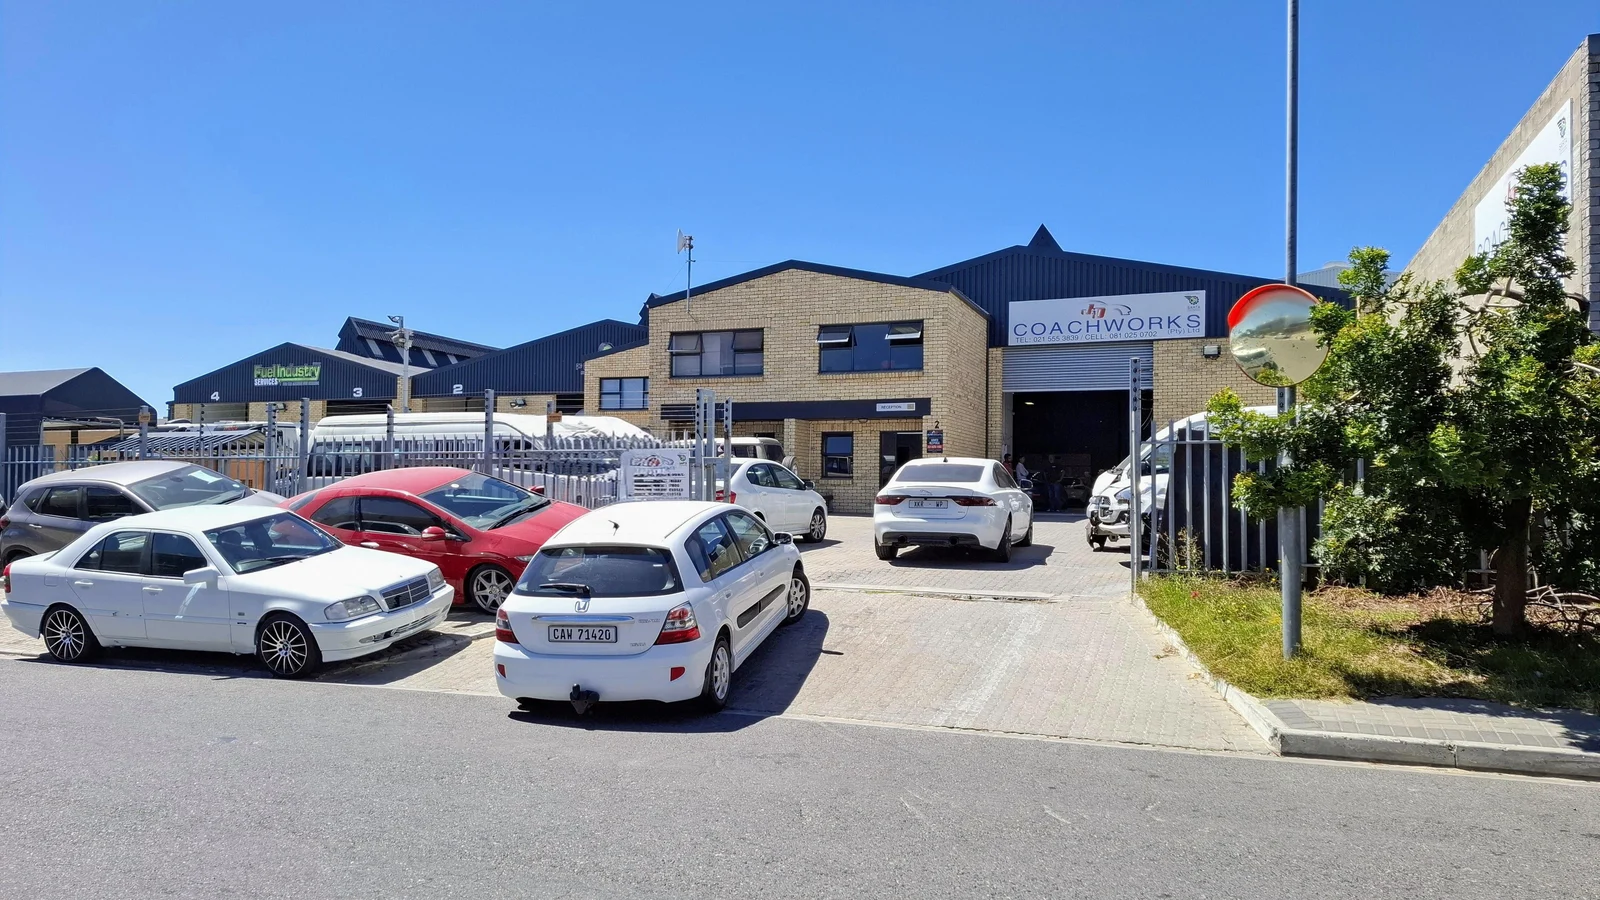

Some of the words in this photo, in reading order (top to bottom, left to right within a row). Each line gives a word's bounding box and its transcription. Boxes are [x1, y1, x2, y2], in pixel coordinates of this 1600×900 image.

[1013, 314, 1201, 337] COACHWORKS
[1015, 336, 1032, 344] TEL:
[1062, 334, 1079, 342] 3839
[1084, 333, 1107, 341] CELL:
[1124, 331, 1138, 339] 025
[1140, 330, 1158, 338] 0702
[253, 364, 276, 378] Fuel
[277, 362, 321, 380] Industry
[253, 377, 279, 386] SERVICES
[353, 387, 363, 397] 3
[453, 384, 463, 394] 2
[210, 391, 220, 401] 4
[934, 420, 940, 429] 2
[553, 629, 573, 640] CAW
[578, 628, 611, 641] 71420
